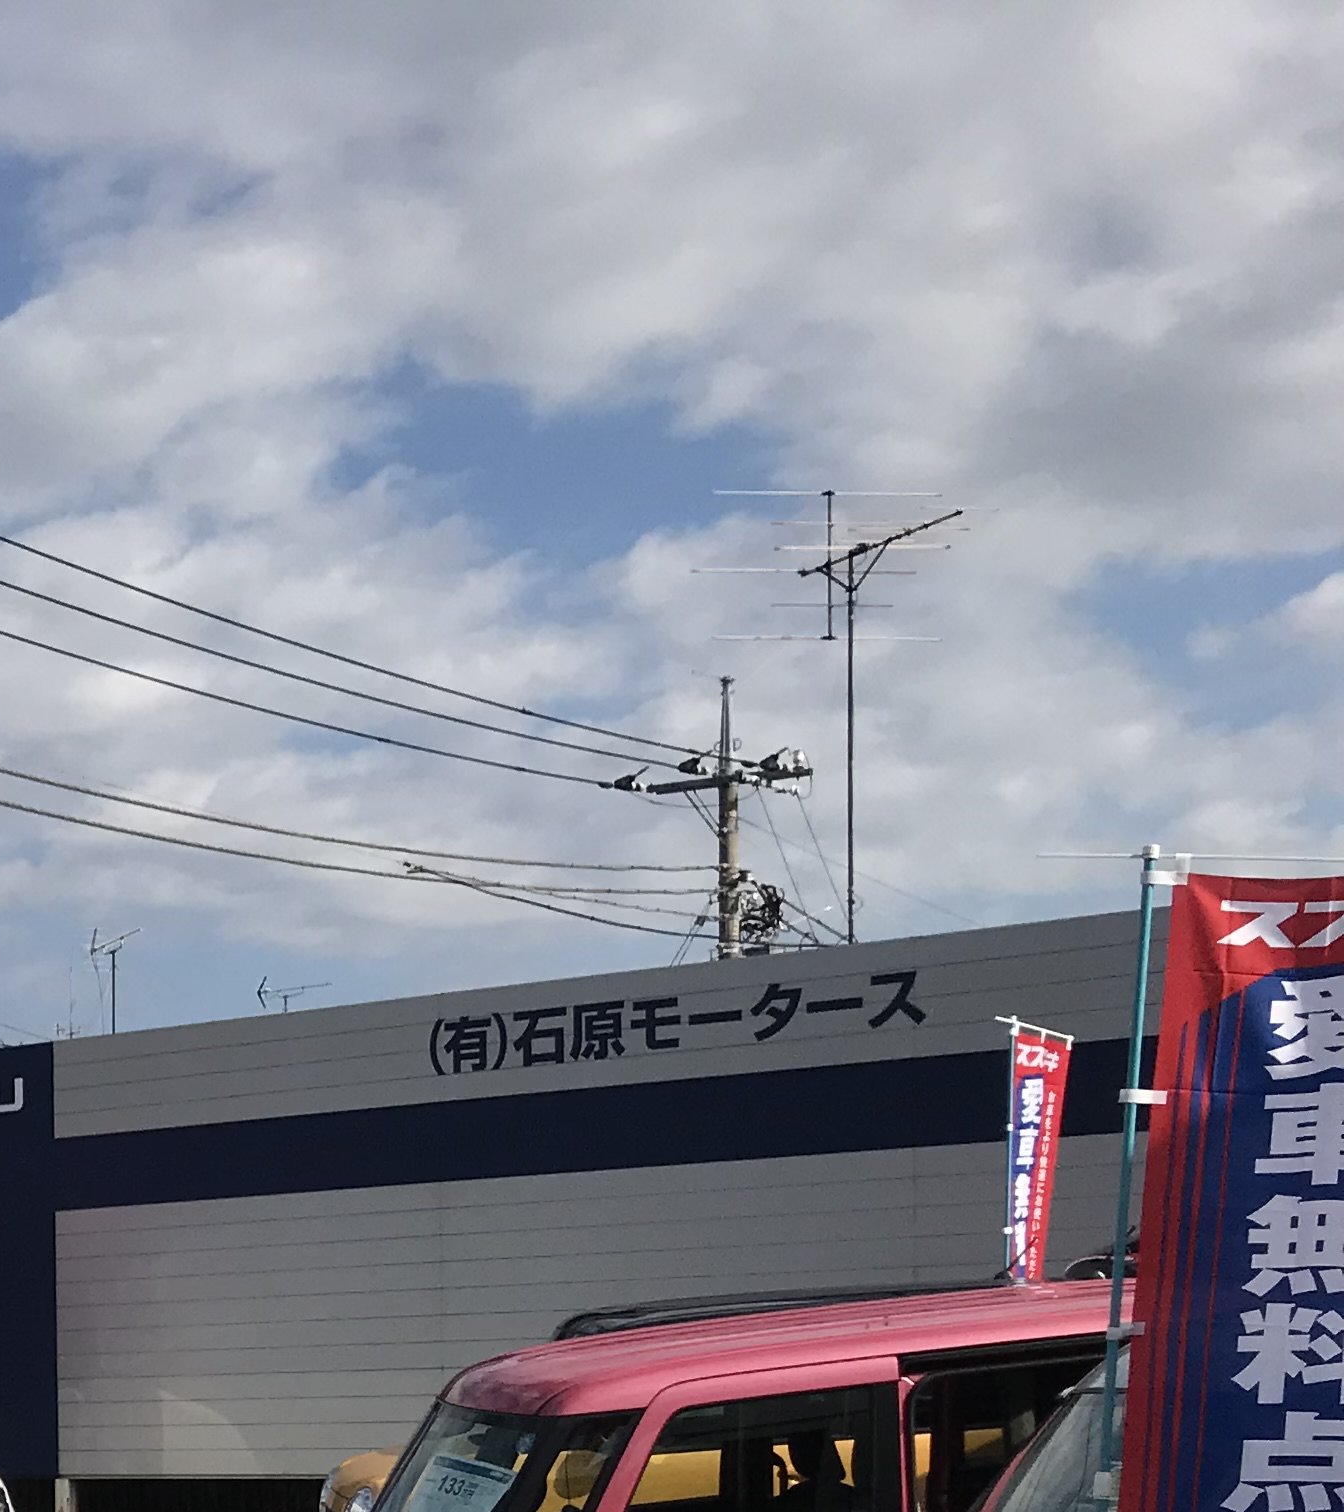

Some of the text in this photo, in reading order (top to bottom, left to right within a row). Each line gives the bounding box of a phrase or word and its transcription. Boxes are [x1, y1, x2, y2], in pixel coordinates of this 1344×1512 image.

[428, 970, 927, 1077] (有)石原モータース
[1016, 1042, 1060, 1073] スズキ
